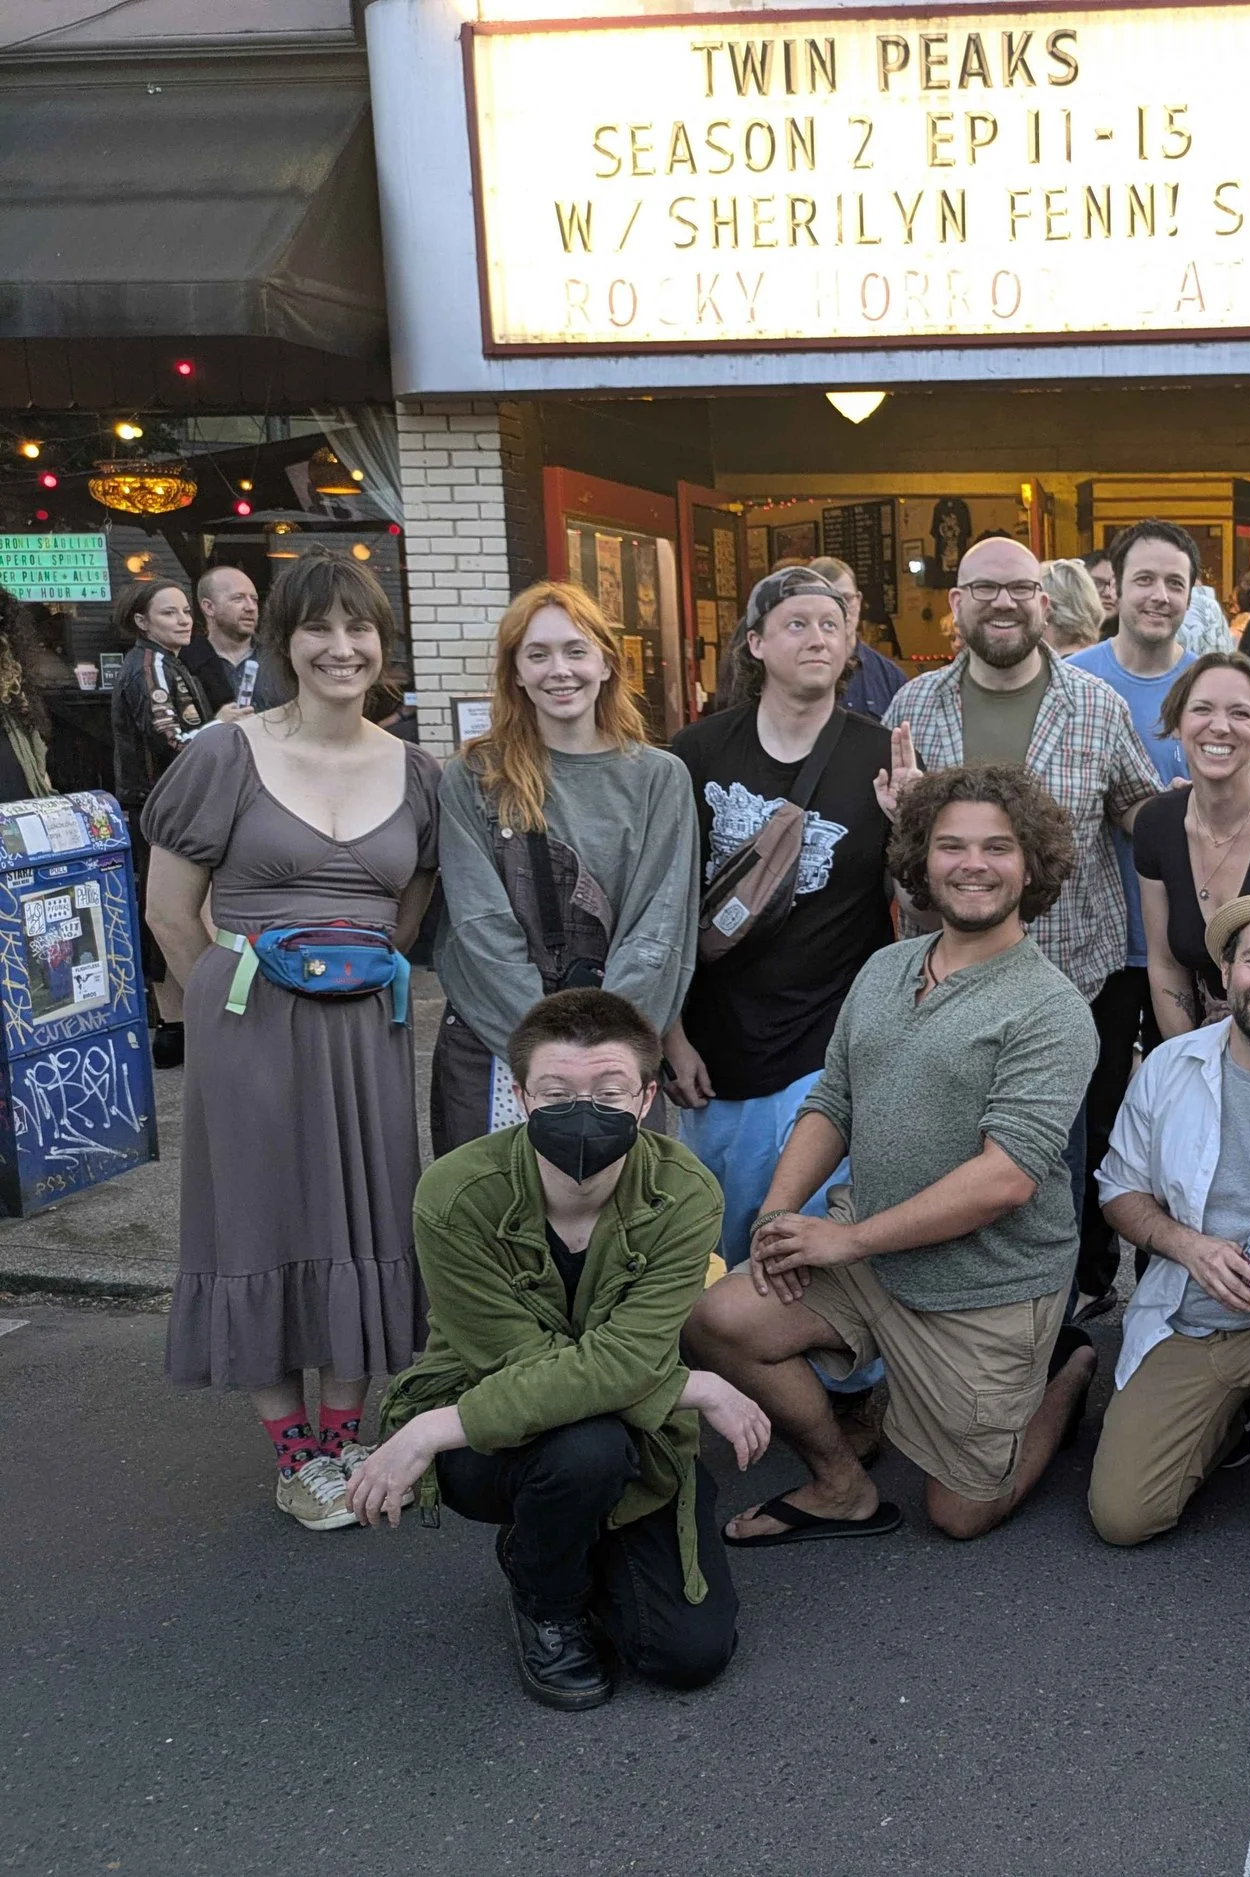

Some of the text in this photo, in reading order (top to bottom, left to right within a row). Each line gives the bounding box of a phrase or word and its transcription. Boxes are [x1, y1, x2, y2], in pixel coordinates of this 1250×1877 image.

[690, 27, 1080, 98] TWIN PEAKS
[591, 115, 816, 179] SEASON
[847, 113, 875, 171] 2
[925, 109, 999, 168] EP
[668, 186, 967, 250] SHERILYN
[1007, 181, 1181, 242] FENN!
[22, 570, 58, 583] PLANE
[51, 553, 95, 566] SPRITZ
[40, 586, 72, 599] HOUR
